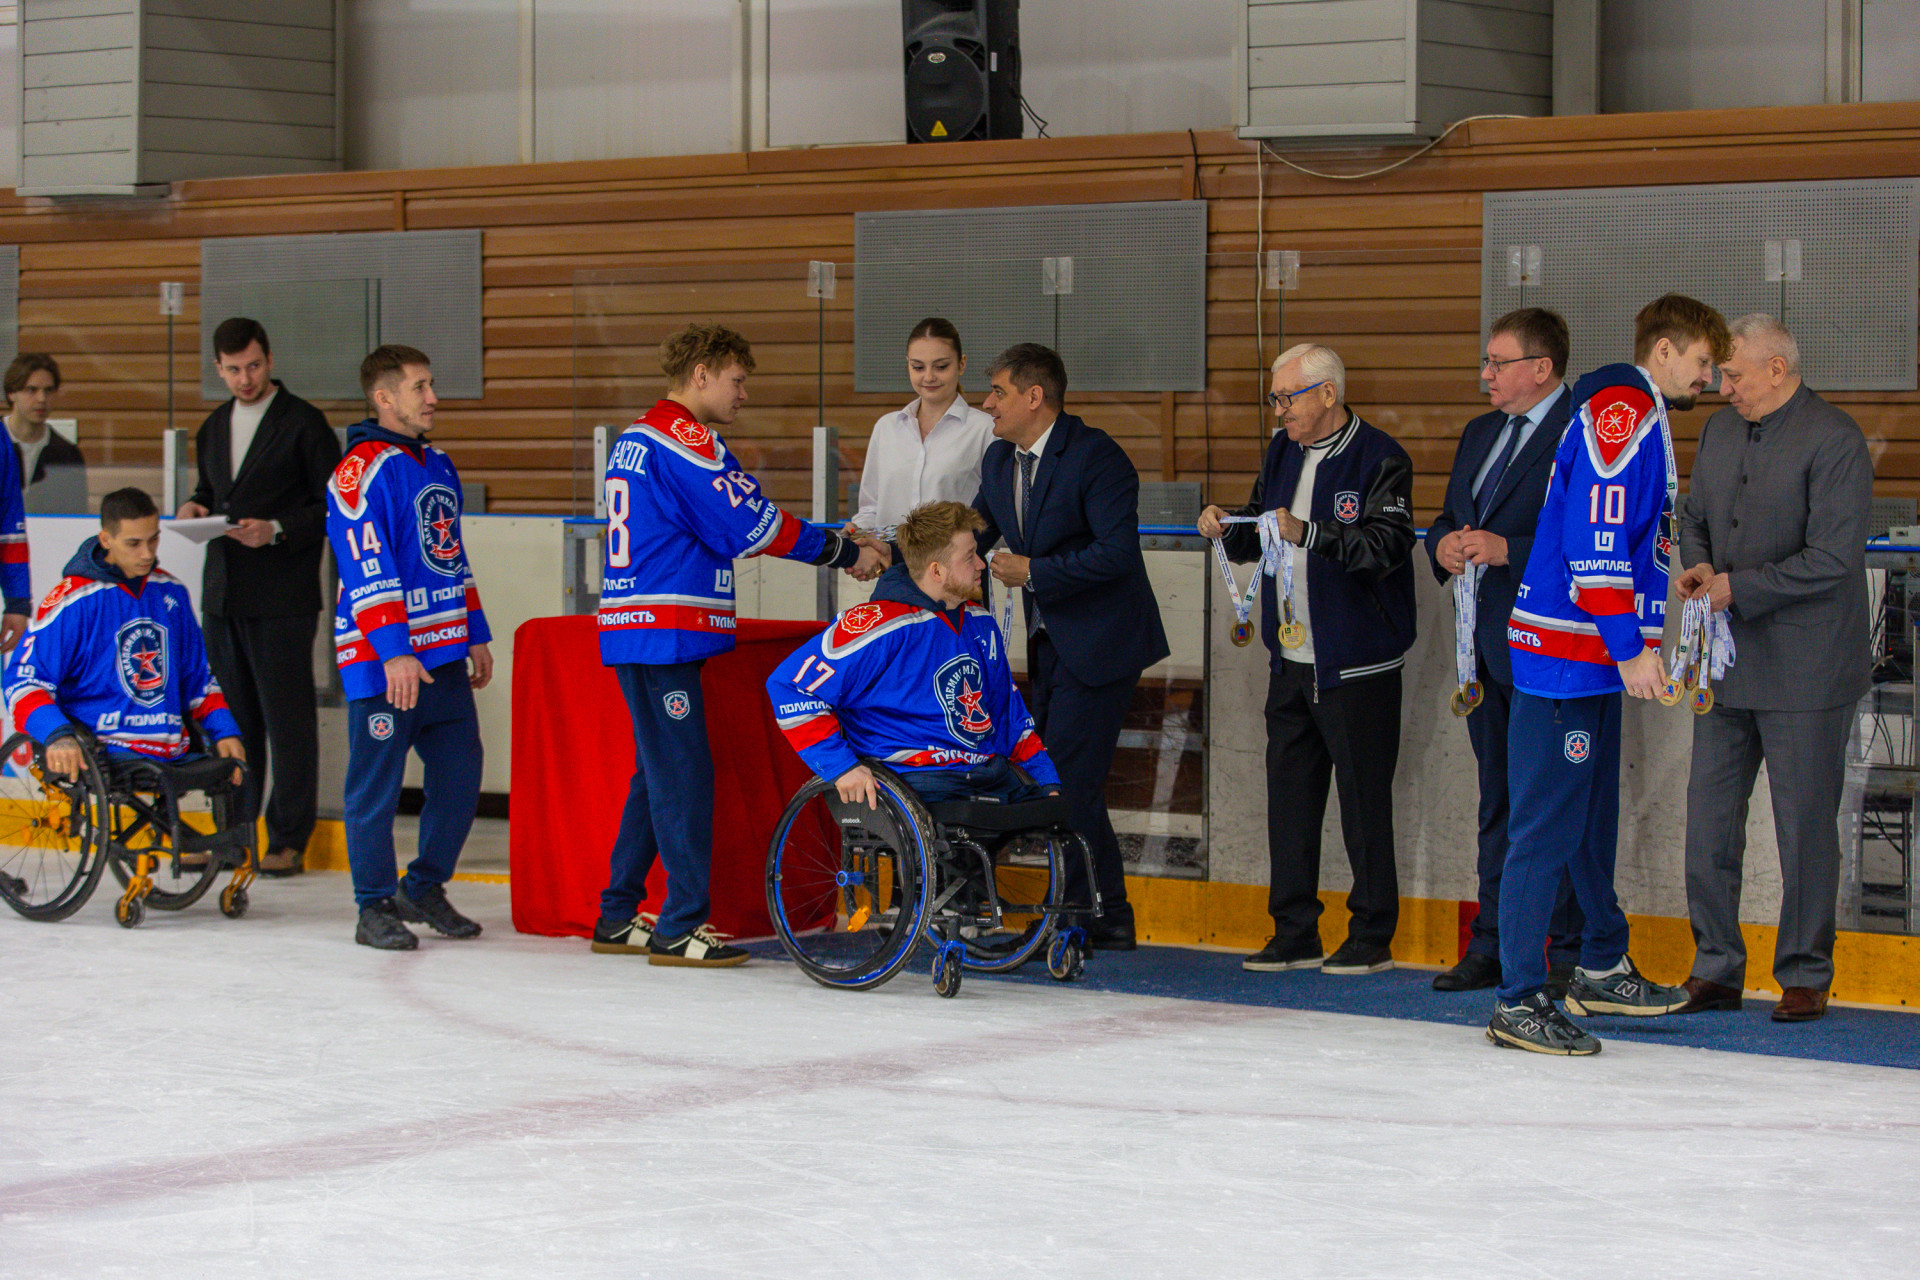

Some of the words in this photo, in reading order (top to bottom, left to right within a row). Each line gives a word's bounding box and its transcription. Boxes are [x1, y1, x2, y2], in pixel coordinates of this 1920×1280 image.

[712, 470, 757, 509] 28
[1589, 484, 1625, 525] 10
[346, 520, 382, 561] 14
[792, 654, 836, 693] 17
[1613, 981, 1639, 999] N
[1517, 1018, 1541, 1037] N
